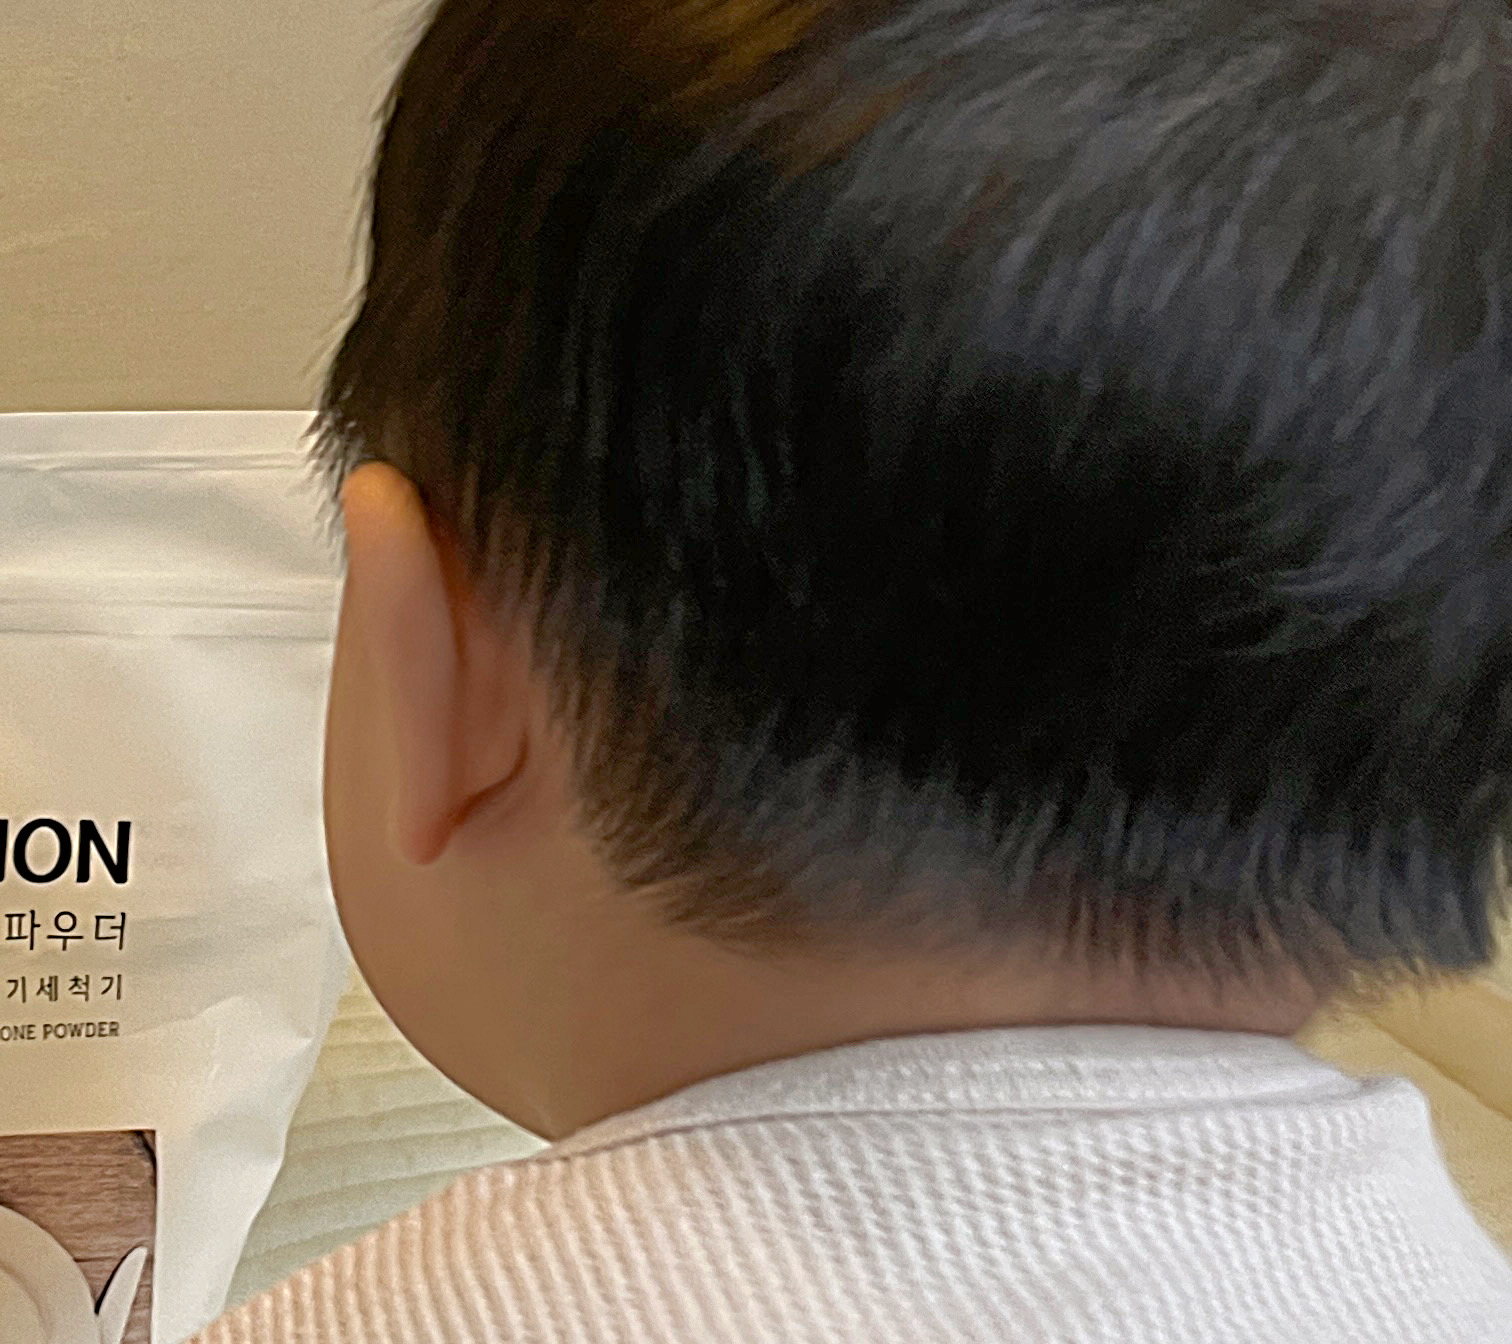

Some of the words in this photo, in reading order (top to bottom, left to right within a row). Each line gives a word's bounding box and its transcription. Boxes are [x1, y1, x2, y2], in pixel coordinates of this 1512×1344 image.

[4, 909, 128, 952] 파우더
[0, 1023, 37, 1042] ONE
[42, 1021, 120, 1040] POWDER
